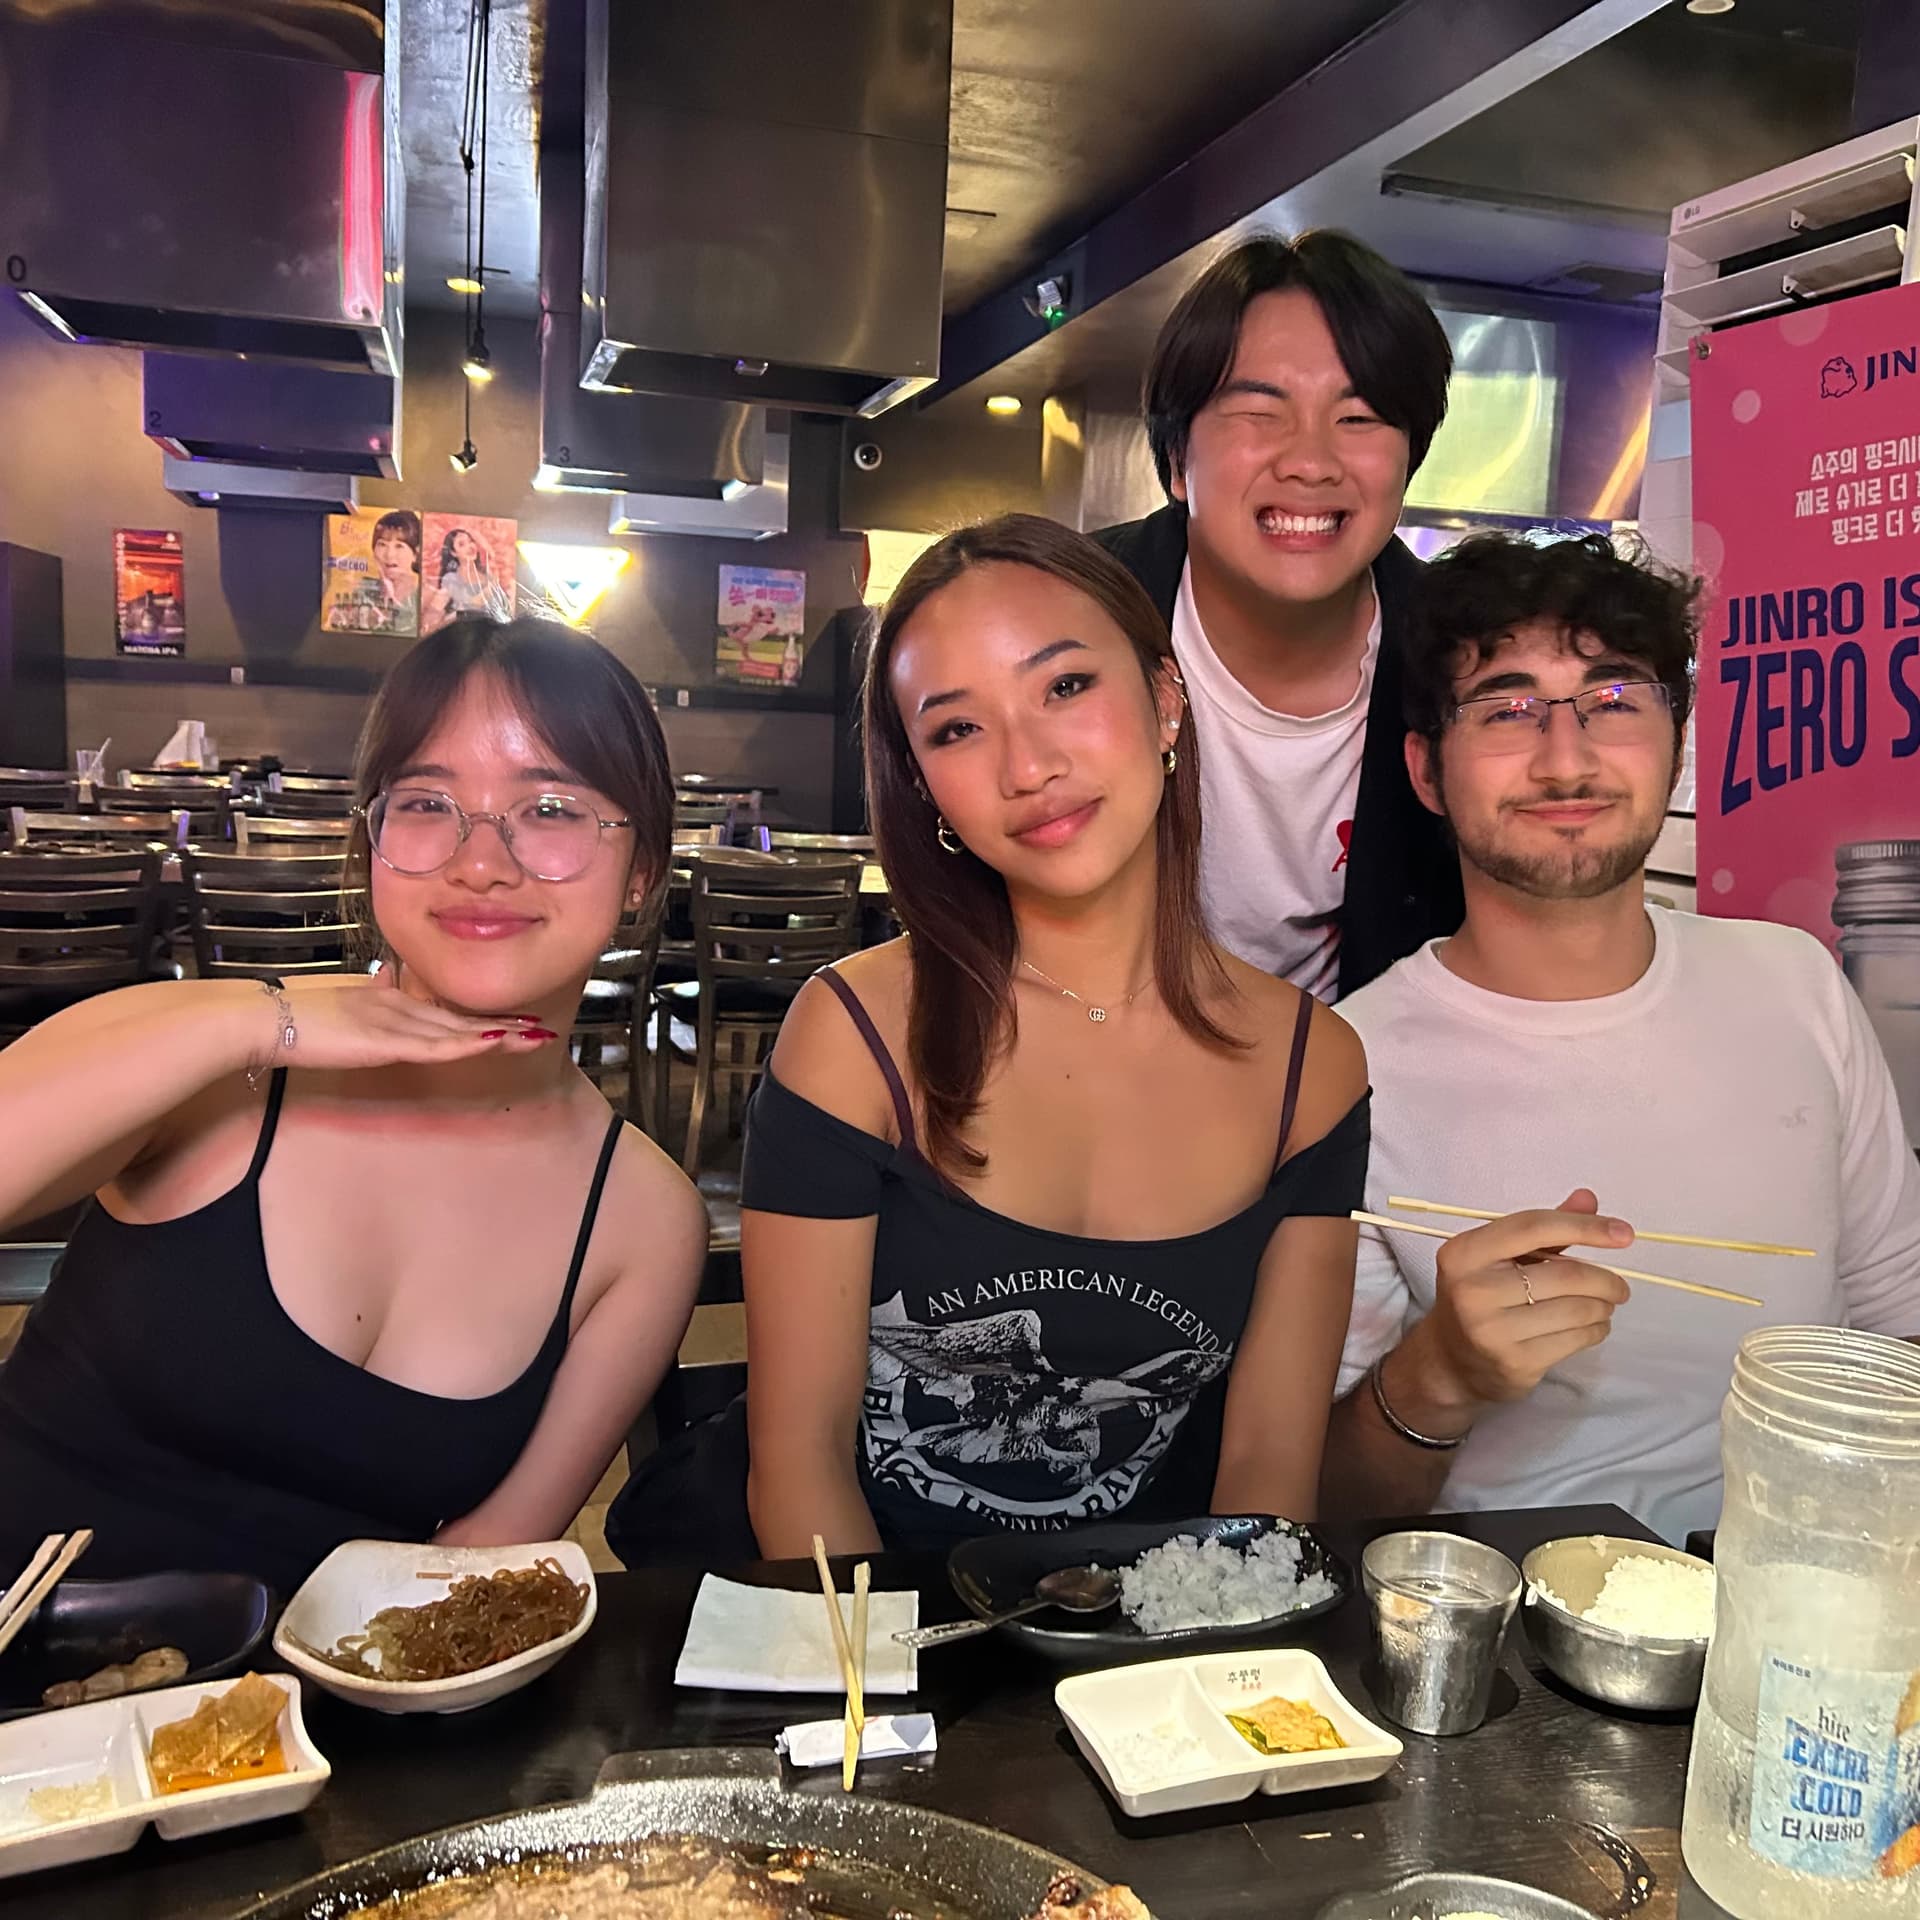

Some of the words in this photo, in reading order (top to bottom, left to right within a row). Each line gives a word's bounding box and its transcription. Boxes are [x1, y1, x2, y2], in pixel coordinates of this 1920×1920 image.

[149, 410, 162, 428] 2
[559, 445, 570, 464] 3
[1810, 446, 1857, 481] 소주의
[1864, 434, 1920, 471] 핑크시
[1795, 486, 1829, 518] 제로
[1836, 477, 1882, 511] 슈거로
[1889, 472, 1907, 501] 더
[1831, 513, 1879, 545] 핑크로
[1885, 508, 1904, 537] 더
[1720, 581, 1864, 648] JINRO
[161, 646, 179, 656] IPA
[1720, 641, 1867, 816] ZERO
[927, 1287, 966, 1317] AN
[973, 1268, 1127, 1305] AMERICAN
[1129, 1281, 1220, 1353] LEGEND
[1783, 1716, 1870, 1785] EXTRA
[1789, 1774, 1862, 1818] COLD
[1781, 1815, 1802, 1840] 더
[1806, 1821, 1865, 1843] 시원하다
